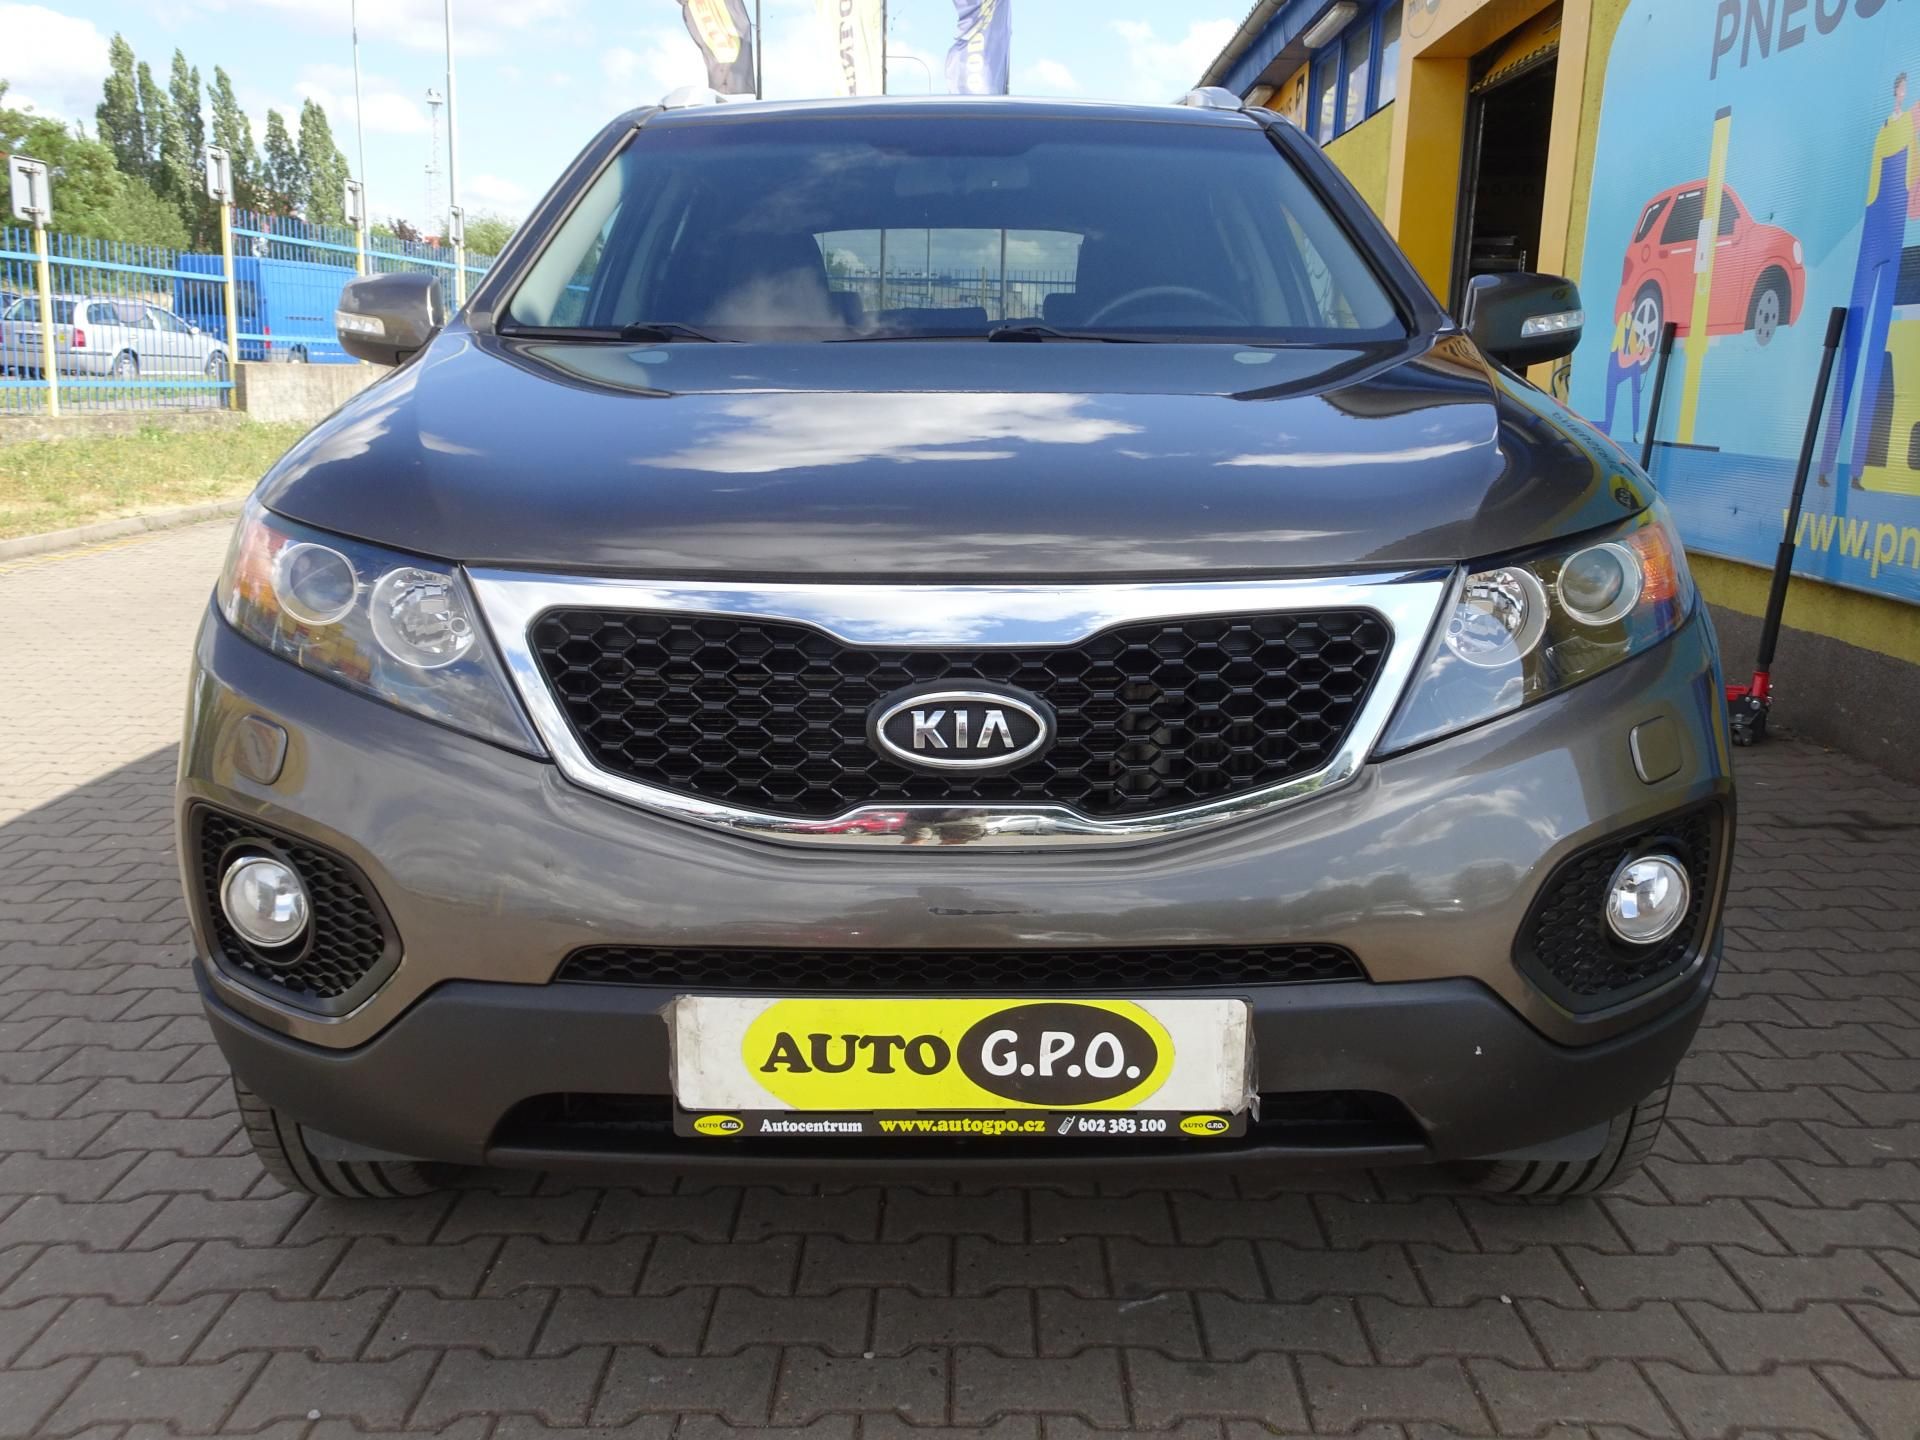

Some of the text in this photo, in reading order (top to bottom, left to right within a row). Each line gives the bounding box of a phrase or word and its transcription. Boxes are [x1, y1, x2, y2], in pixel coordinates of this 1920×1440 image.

[910, 709, 1015, 749] KIA
[760, 1029, 1141, 1079] AUTO G.P.O.
[760, 1117, 1167, 1135] Autocentrum www.autogpo.cz 602 383 100
